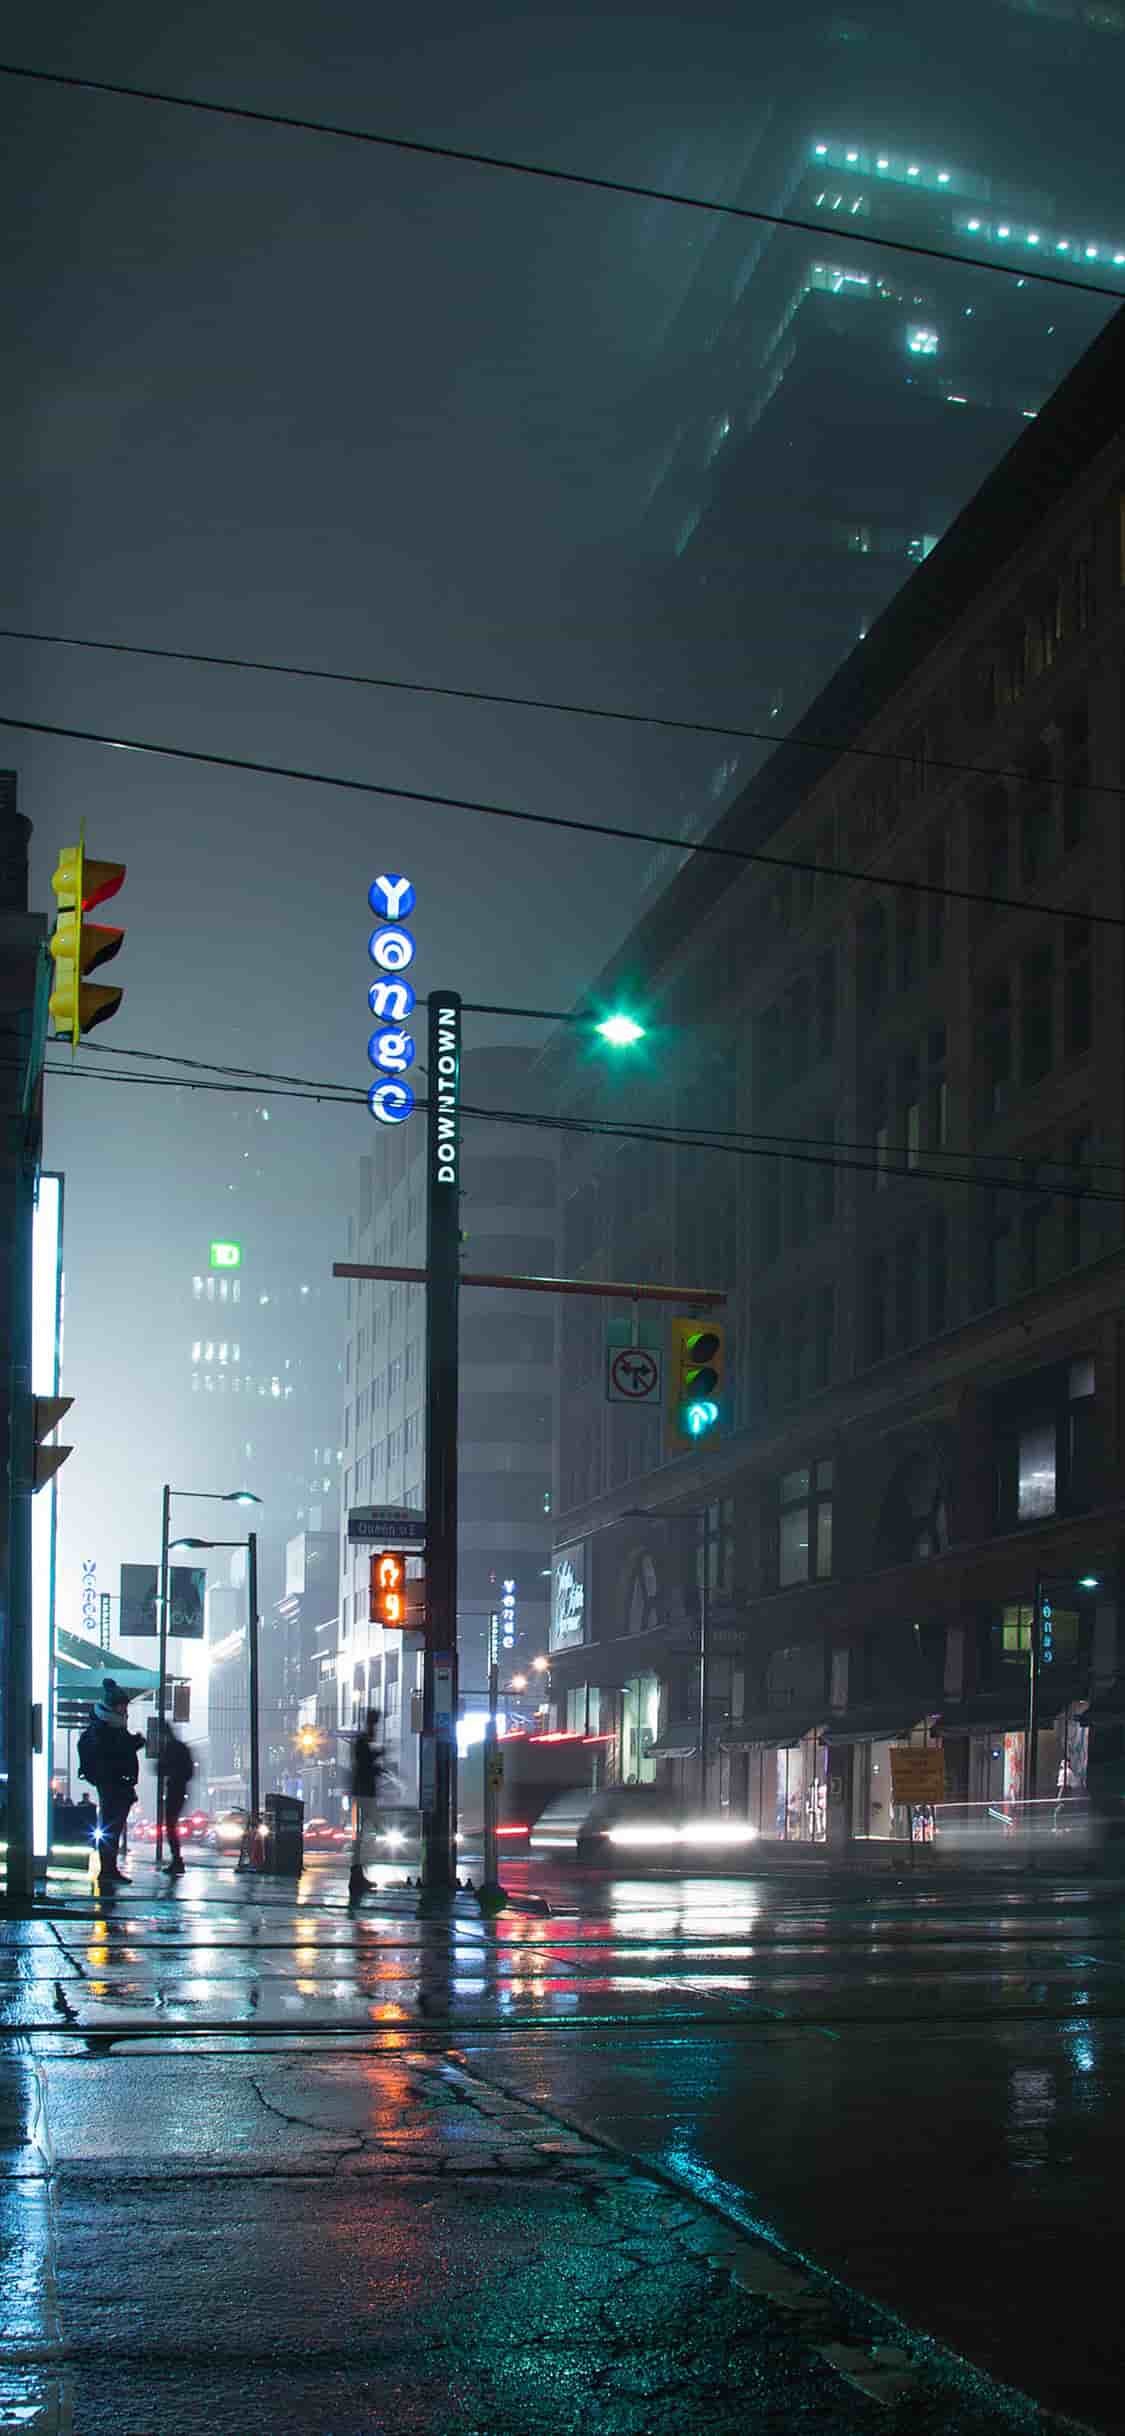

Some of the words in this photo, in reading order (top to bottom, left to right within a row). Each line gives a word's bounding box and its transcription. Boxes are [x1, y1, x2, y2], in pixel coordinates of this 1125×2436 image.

[369, 874, 413, 1124] Yonge
[438, 1008, 456, 1183] DOWNTOWN
[385, 1594, 399, 1620] 9
